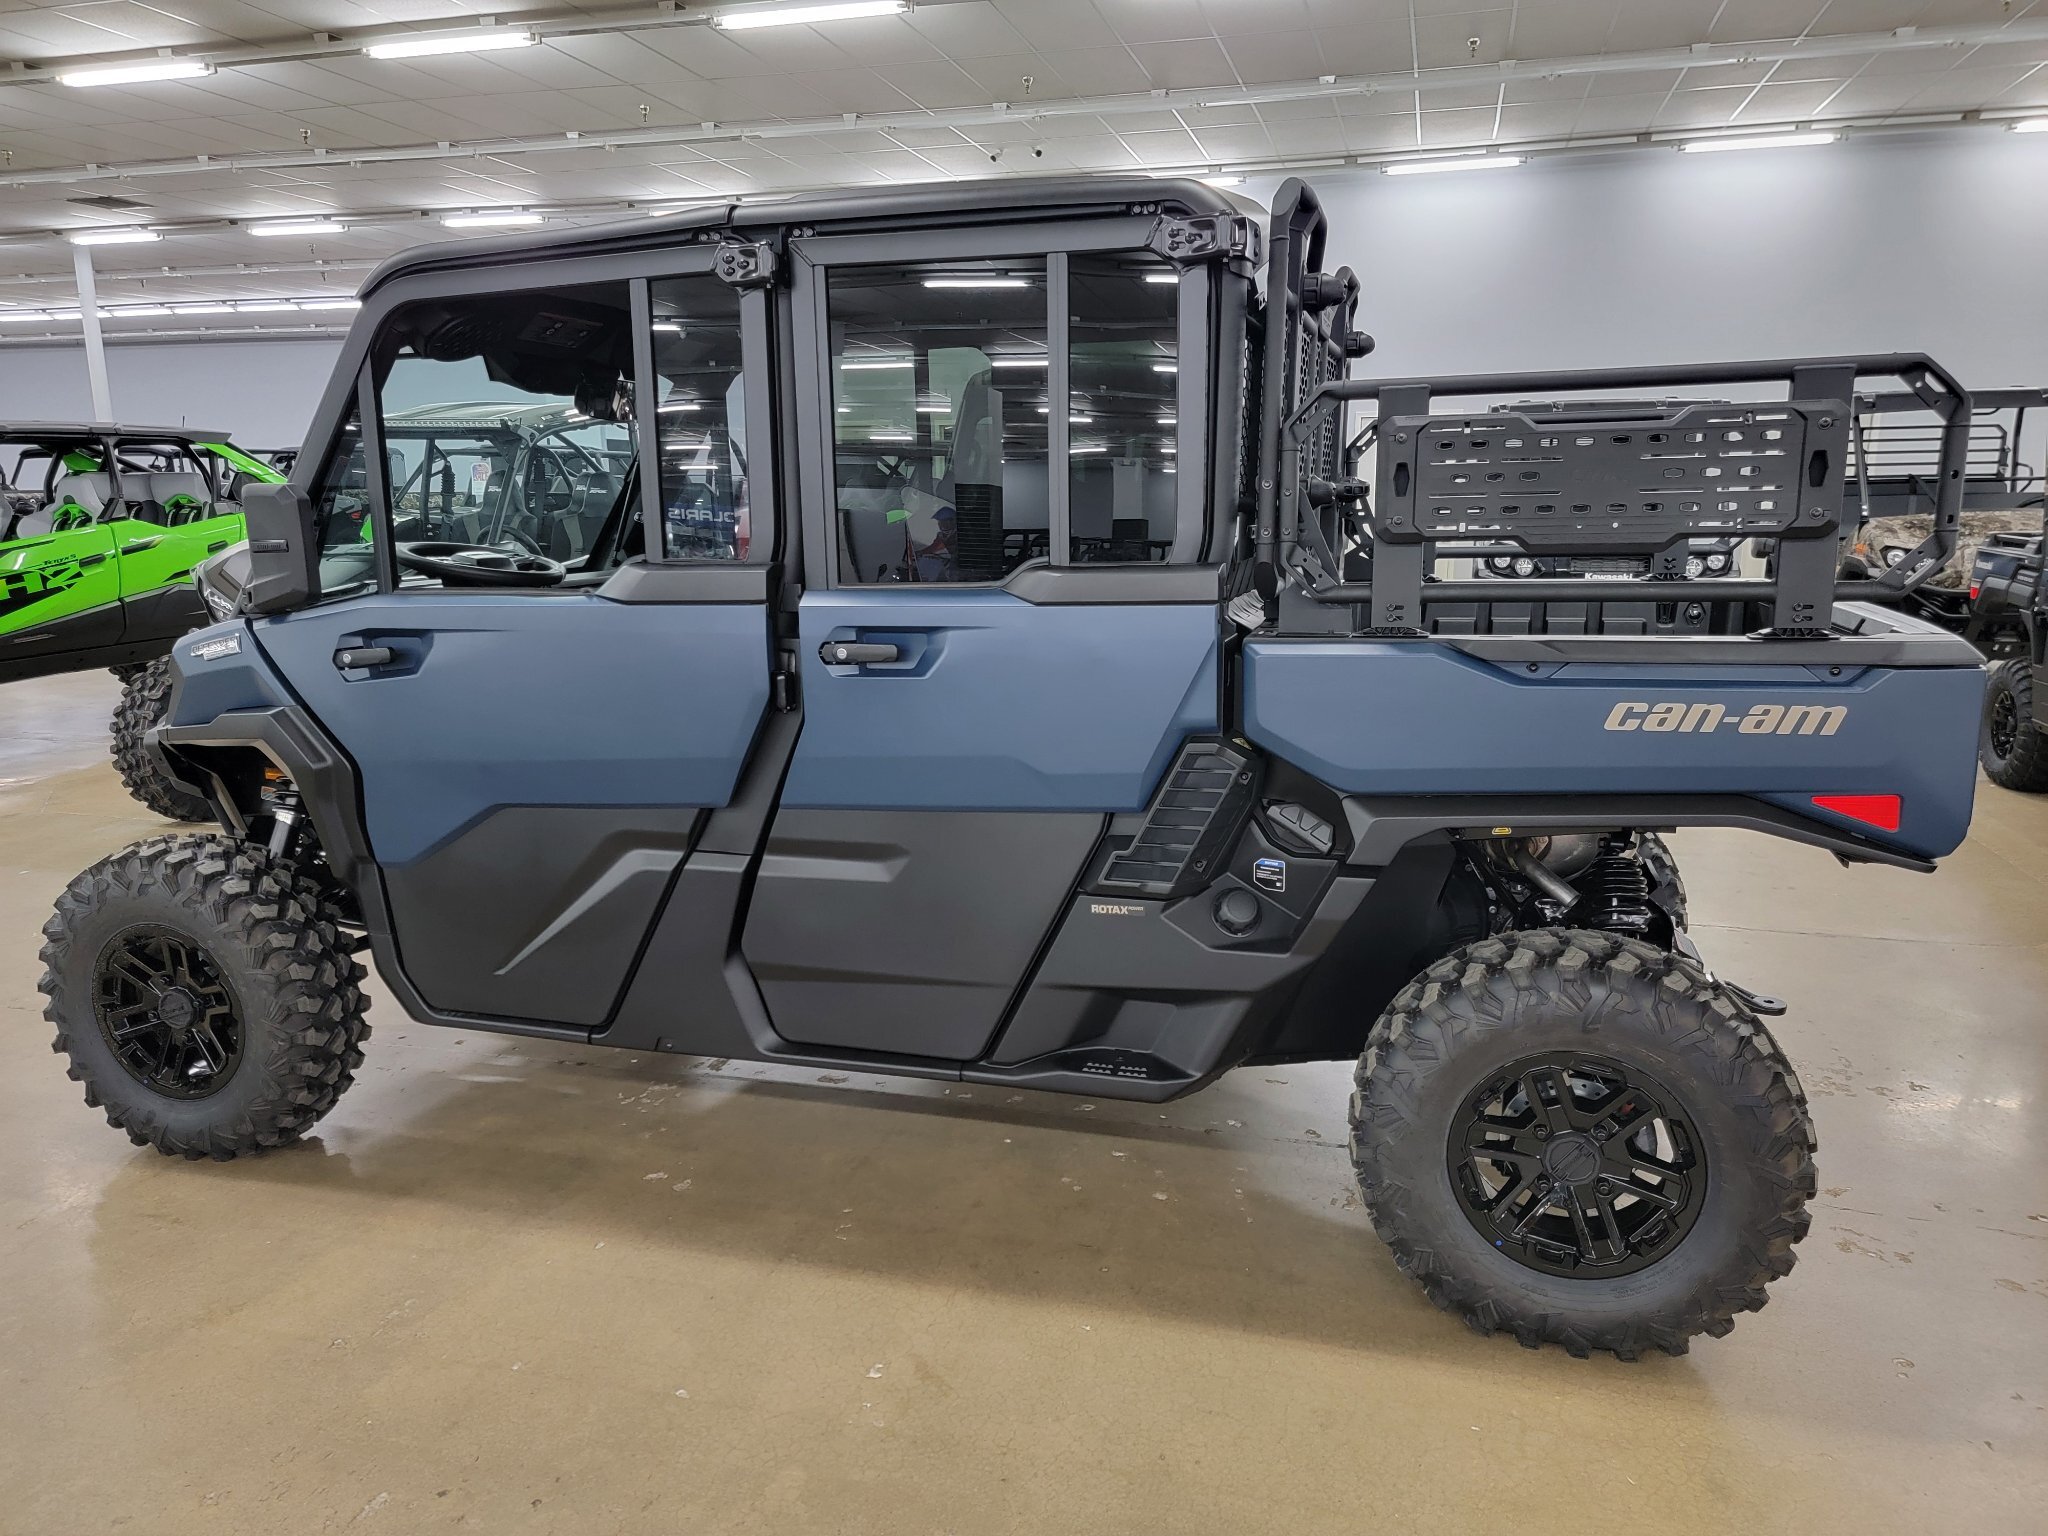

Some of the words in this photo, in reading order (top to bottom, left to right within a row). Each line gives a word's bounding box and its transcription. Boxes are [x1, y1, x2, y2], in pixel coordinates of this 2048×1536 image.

[1585, 572, 1633, 580] Kawasaki
[1603, 702, 1848, 736] can-am
[1091, 904, 1128, 915] ROTAX
